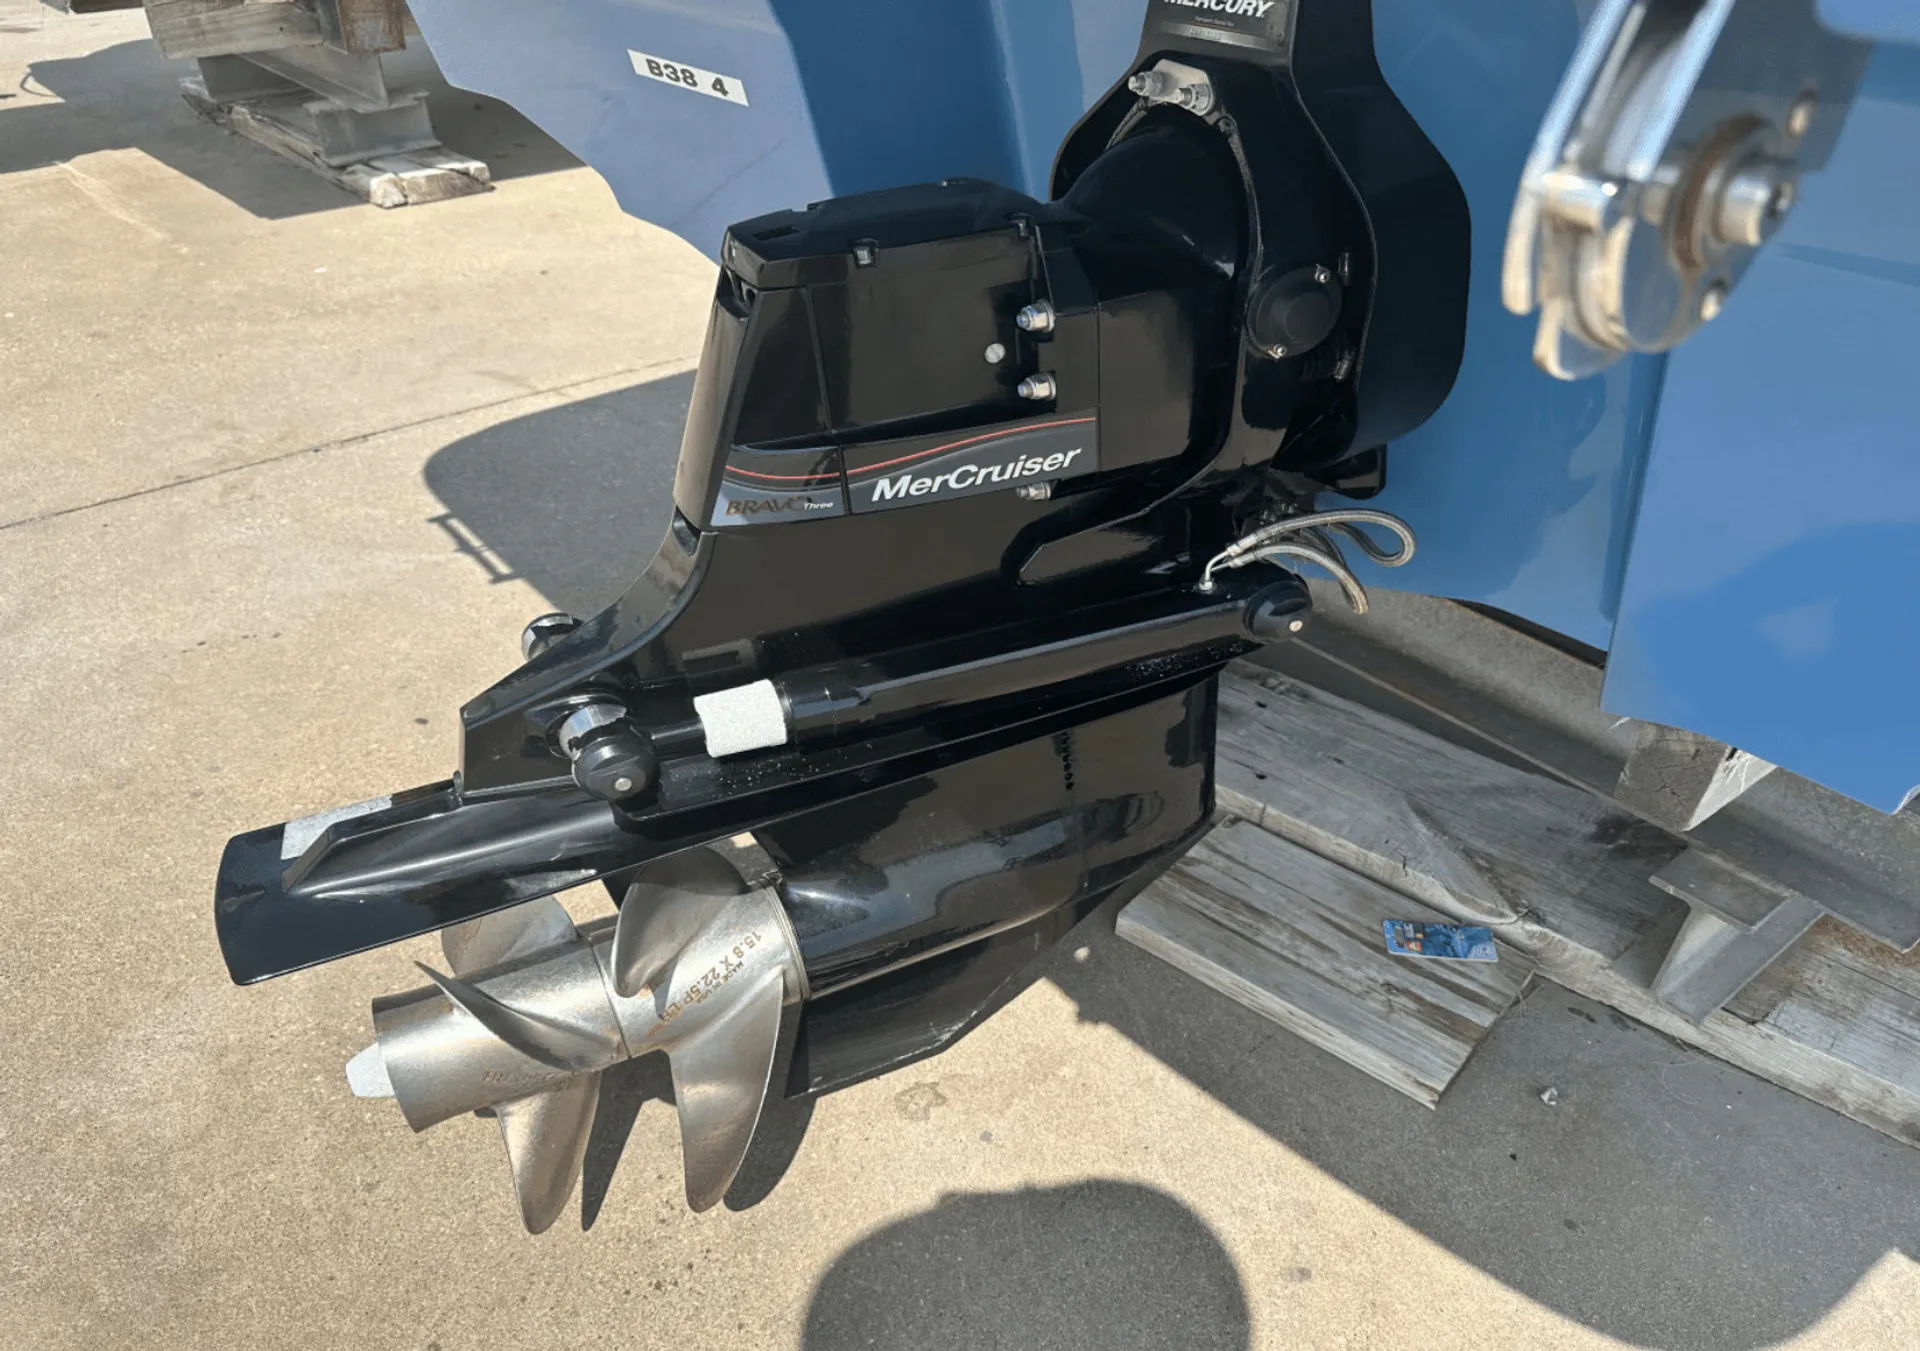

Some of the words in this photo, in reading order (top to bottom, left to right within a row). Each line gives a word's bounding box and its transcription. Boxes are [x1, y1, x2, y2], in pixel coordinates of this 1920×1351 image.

[1164, 0, 1275, 18] RCURY
[646, 58, 698, 88] B38
[711, 77, 729, 97] 4
[871, 448, 1083, 502] MerCruiser
[724, 496, 812, 516] BRAVO
[803, 501, 834, 511] Three
[720, 955, 734, 971] X
[721, 961, 745, 982] MADE
[684, 967, 721, 1006] 22.5P
